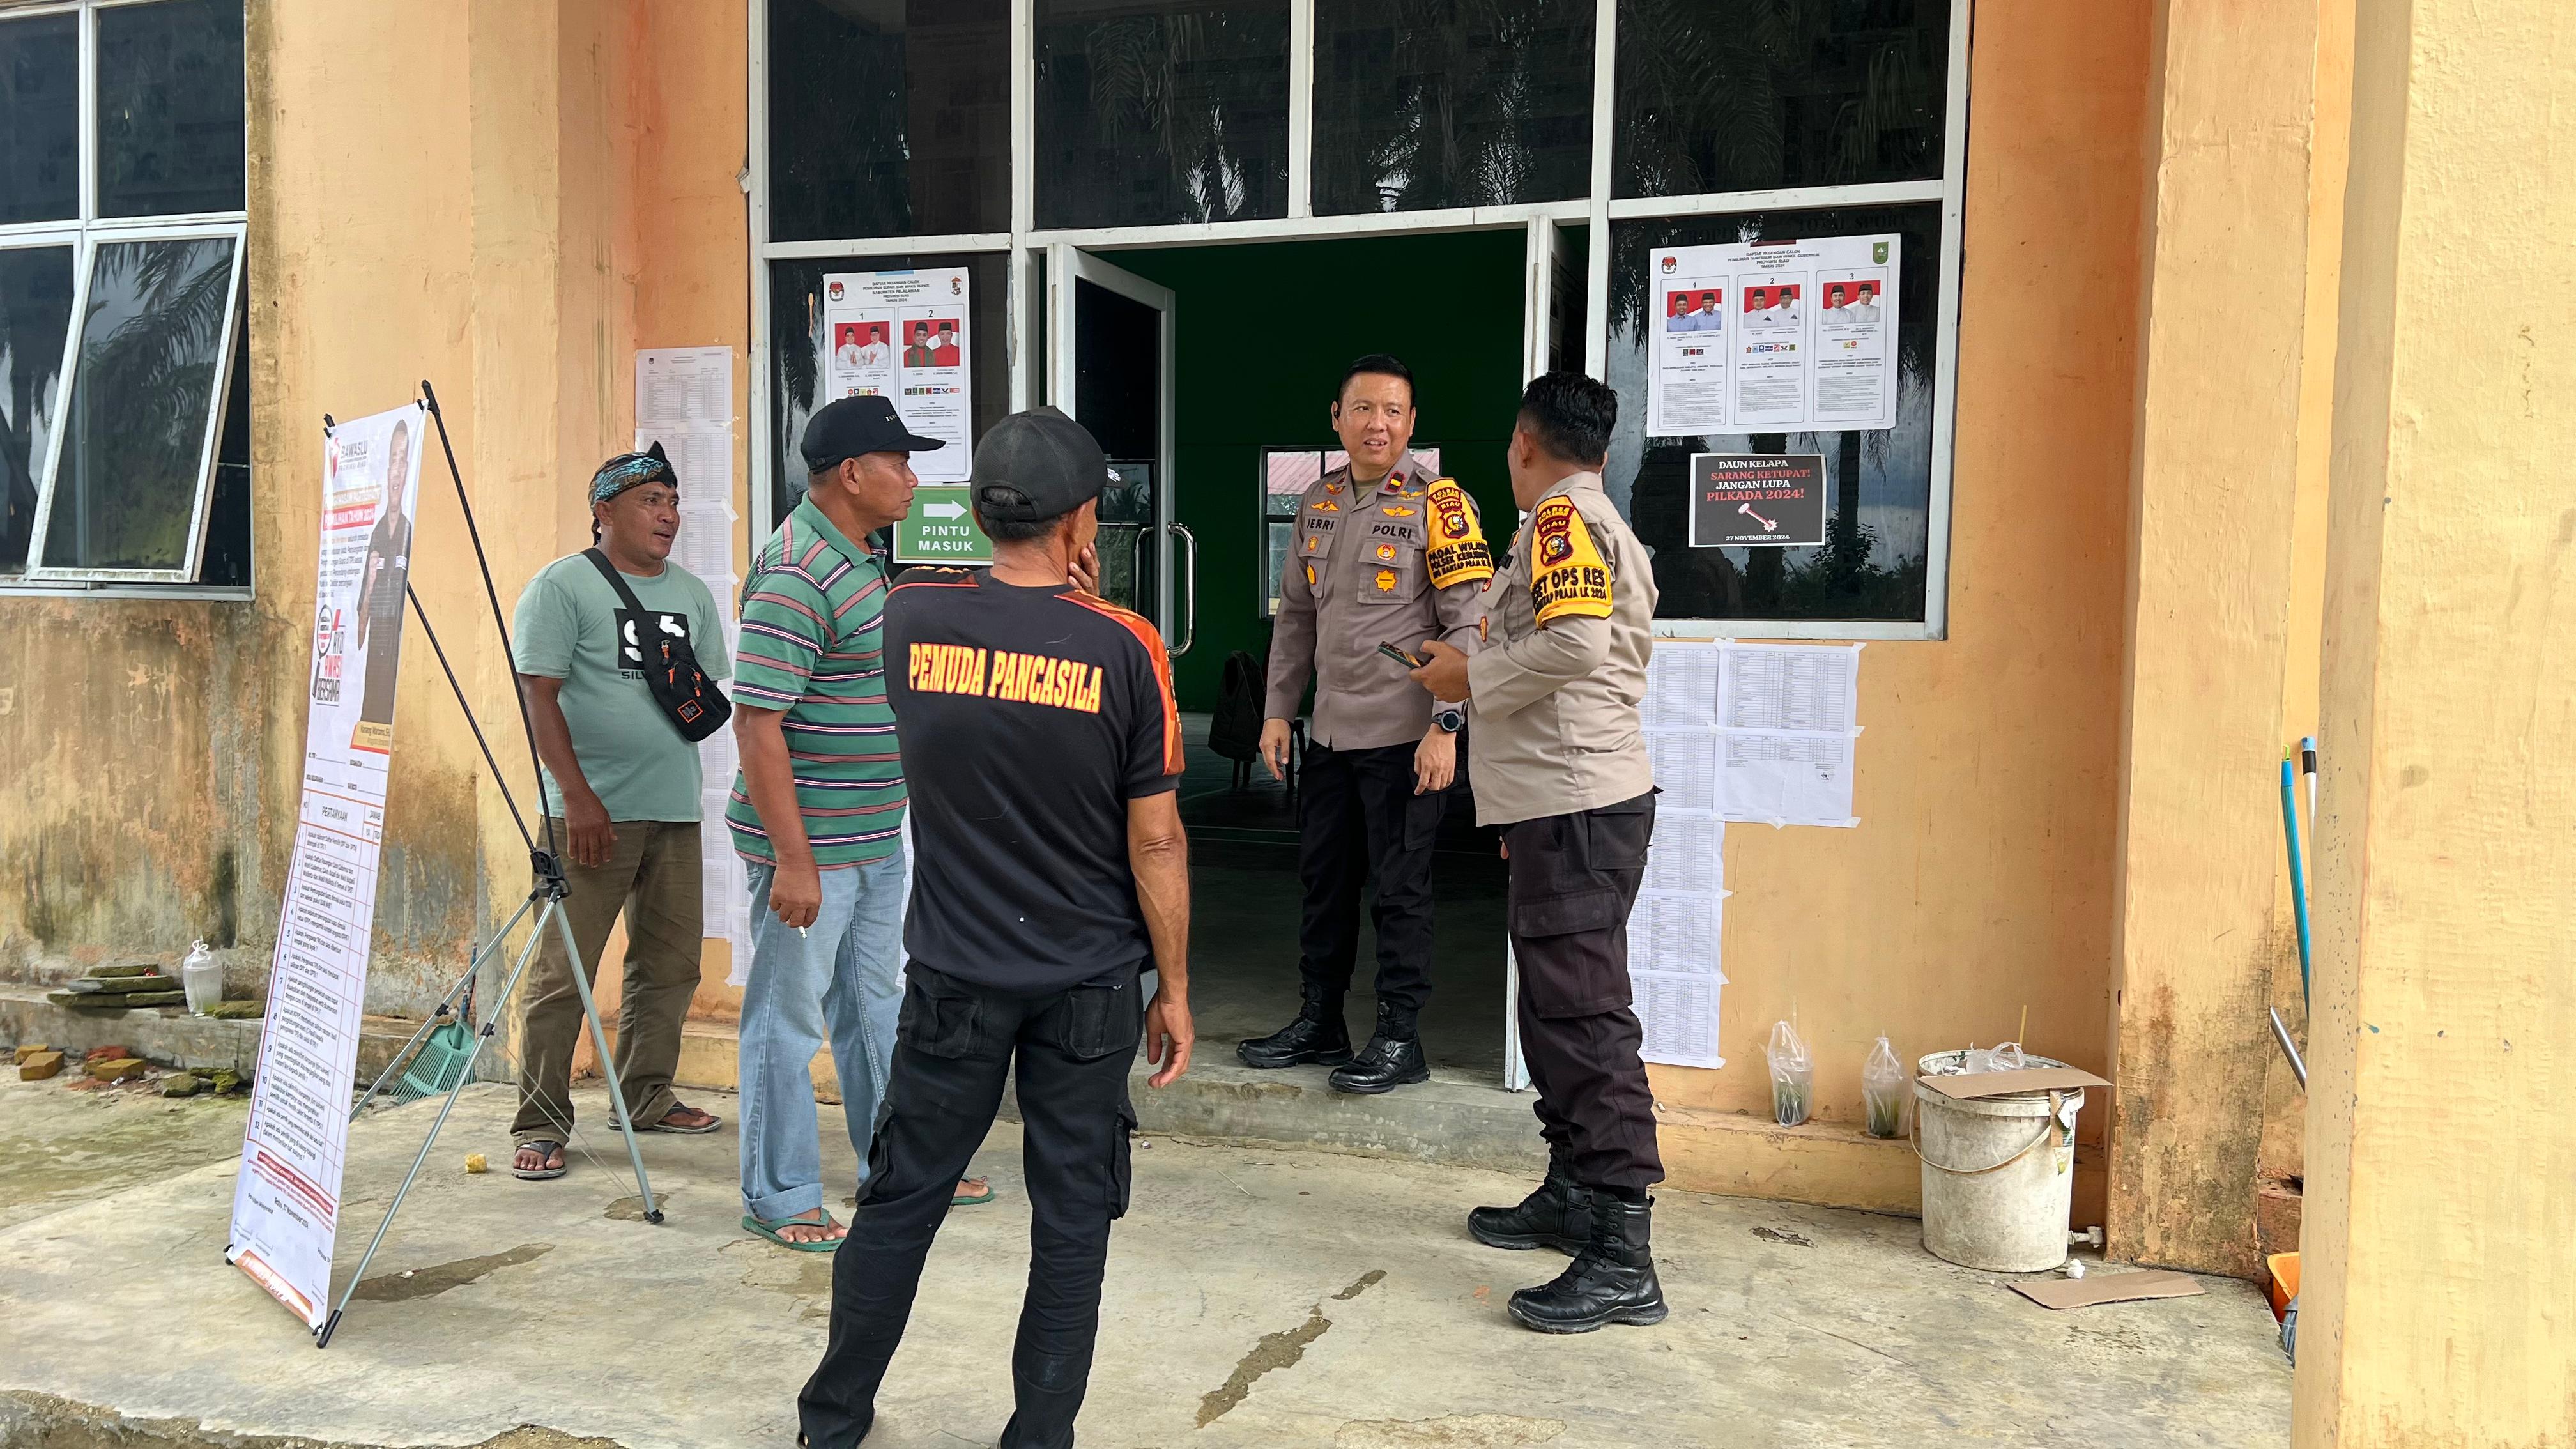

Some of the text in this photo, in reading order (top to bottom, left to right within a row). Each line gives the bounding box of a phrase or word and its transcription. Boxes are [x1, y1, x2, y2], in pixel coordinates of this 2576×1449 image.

[1719, 459, 1789, 470] DAUN KELAPA
[1710, 469, 1811, 480] SARANG KETUPAT!
[1715, 480, 1791, 490] JANGAN LUPA
[1706, 488, 1804, 502] PILKADA 2024!
[1307, 518, 1335, 531] JERRI
[1541, 521, 1566, 532] RIAU
[922, 526, 970, 536] PINTU
[1372, 525, 1412, 539] POLRI
[918, 541, 974, 551] MASUK
[1552, 568, 1579, 588] OPS
[1583, 567, 1605, 587] RES
[1555, 588, 1578, 601] PRAJA
[1580, 587, 1590, 597] LK
[908, 642, 1103, 714] PEMUDA PANCASILA
[322, 806, 348, 821] PERTANYAAN
[255, 1121, 259, 1129] 12
